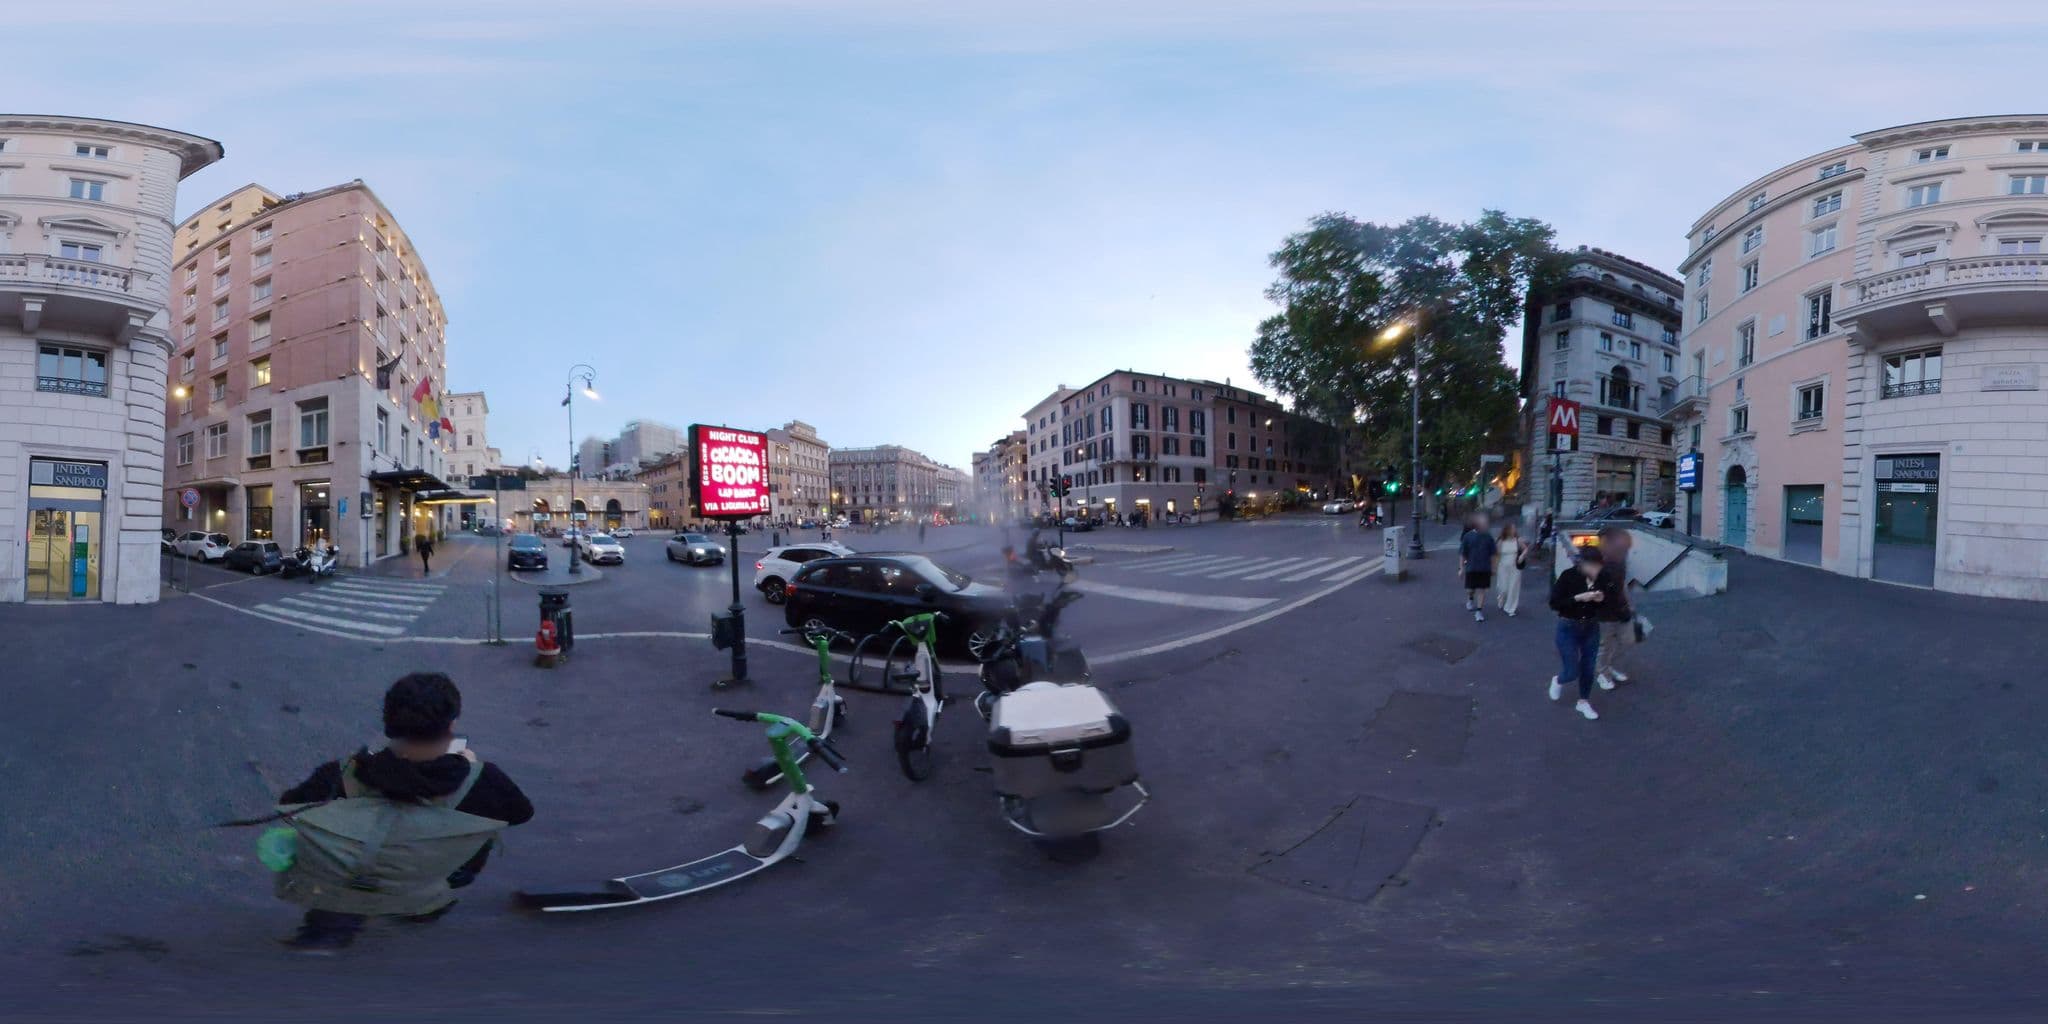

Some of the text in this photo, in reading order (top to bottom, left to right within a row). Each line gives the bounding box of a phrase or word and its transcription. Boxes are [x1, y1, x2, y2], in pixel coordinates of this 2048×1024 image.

[1551, 405, 1578, 428] M
[709, 430, 759, 445] NIGHT CLUB
[710, 446, 760, 466] CICACICA
[1895, 458, 1925, 468] INTESA
[55, 464, 91, 476] INTESA
[711, 464, 760, 485] BOOM
[718, 488, 733, 498] LAP
[704, 502, 719, 511] VIA
